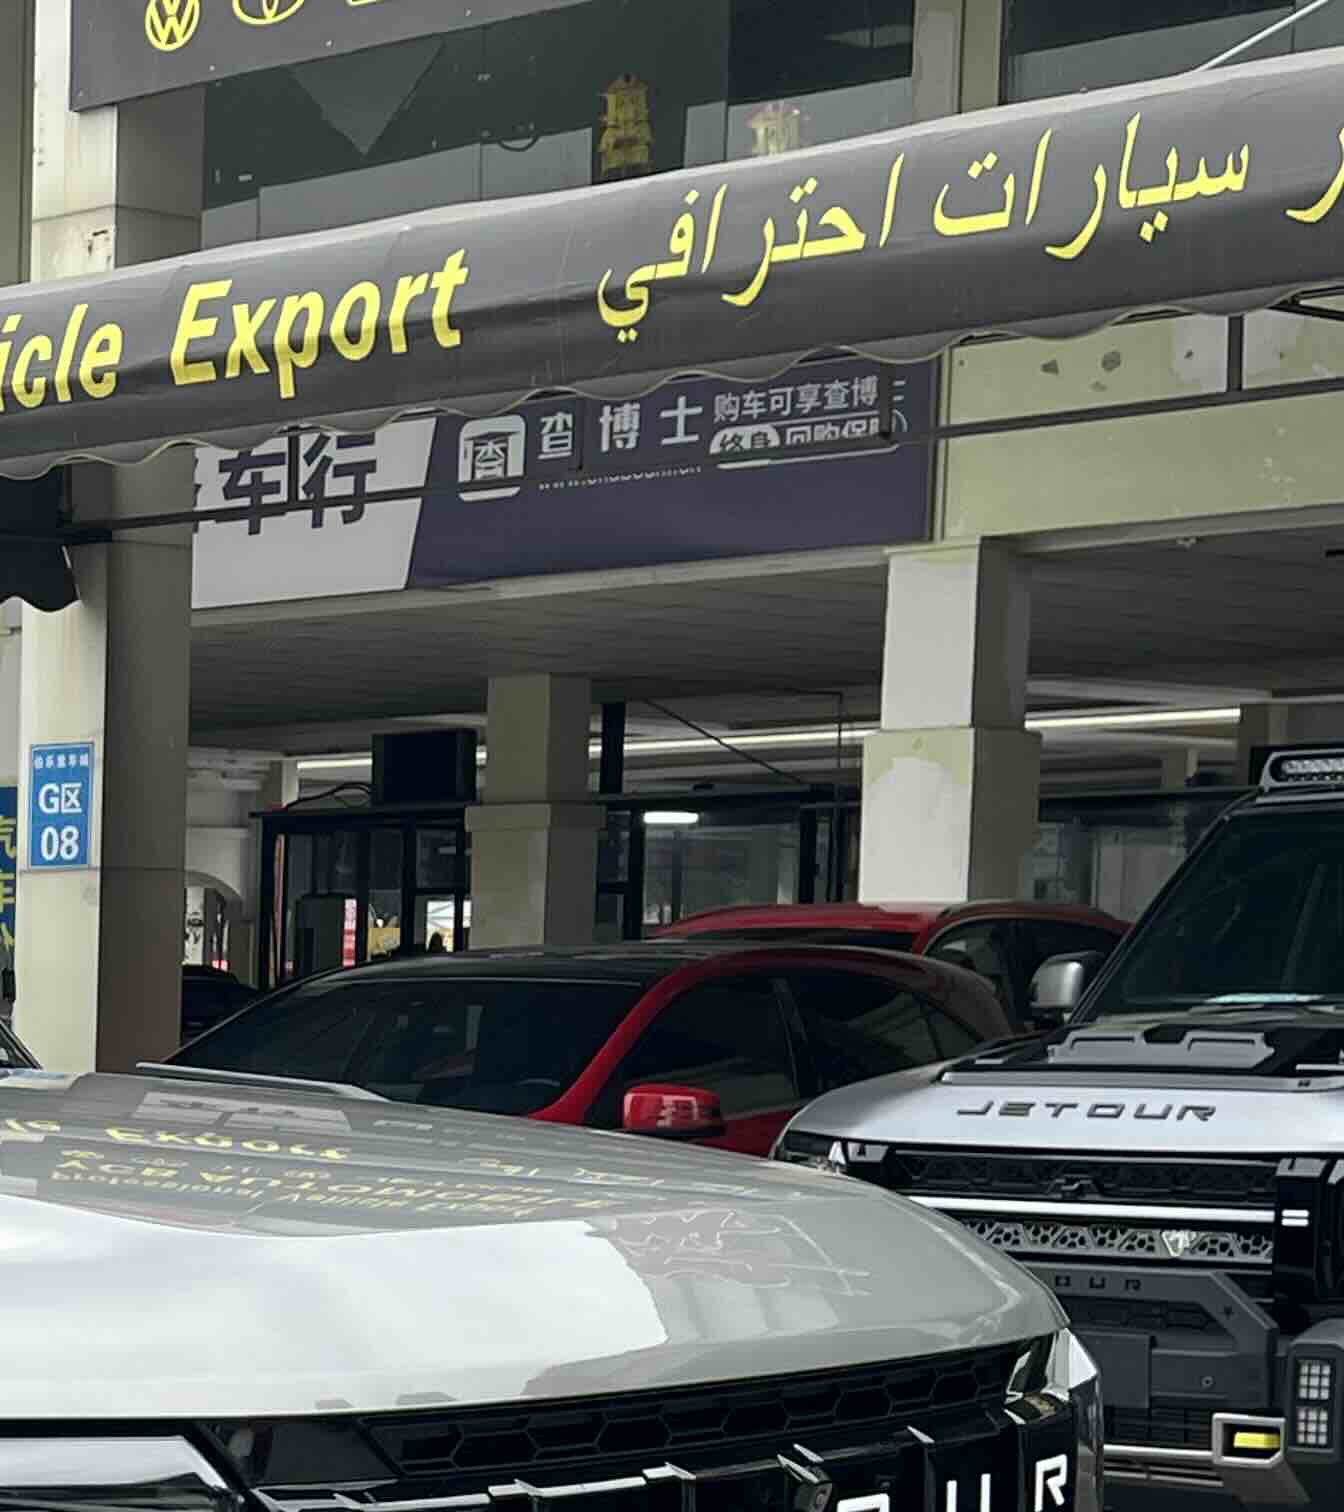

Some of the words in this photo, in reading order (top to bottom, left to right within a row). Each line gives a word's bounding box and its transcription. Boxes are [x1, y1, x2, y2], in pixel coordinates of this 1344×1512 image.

[932, 111, 1251, 261] سيارات
[597, 152, 906, 343] احترافي
[169, 247, 471, 400] Export
[537, 395, 704, 460] 查博士
[195, 431, 378, 536] 车行
[38, 782, 83, 815] G区
[39, 824, 81, 862] 08
[957, 1100, 1218, 1122] JETOUR
